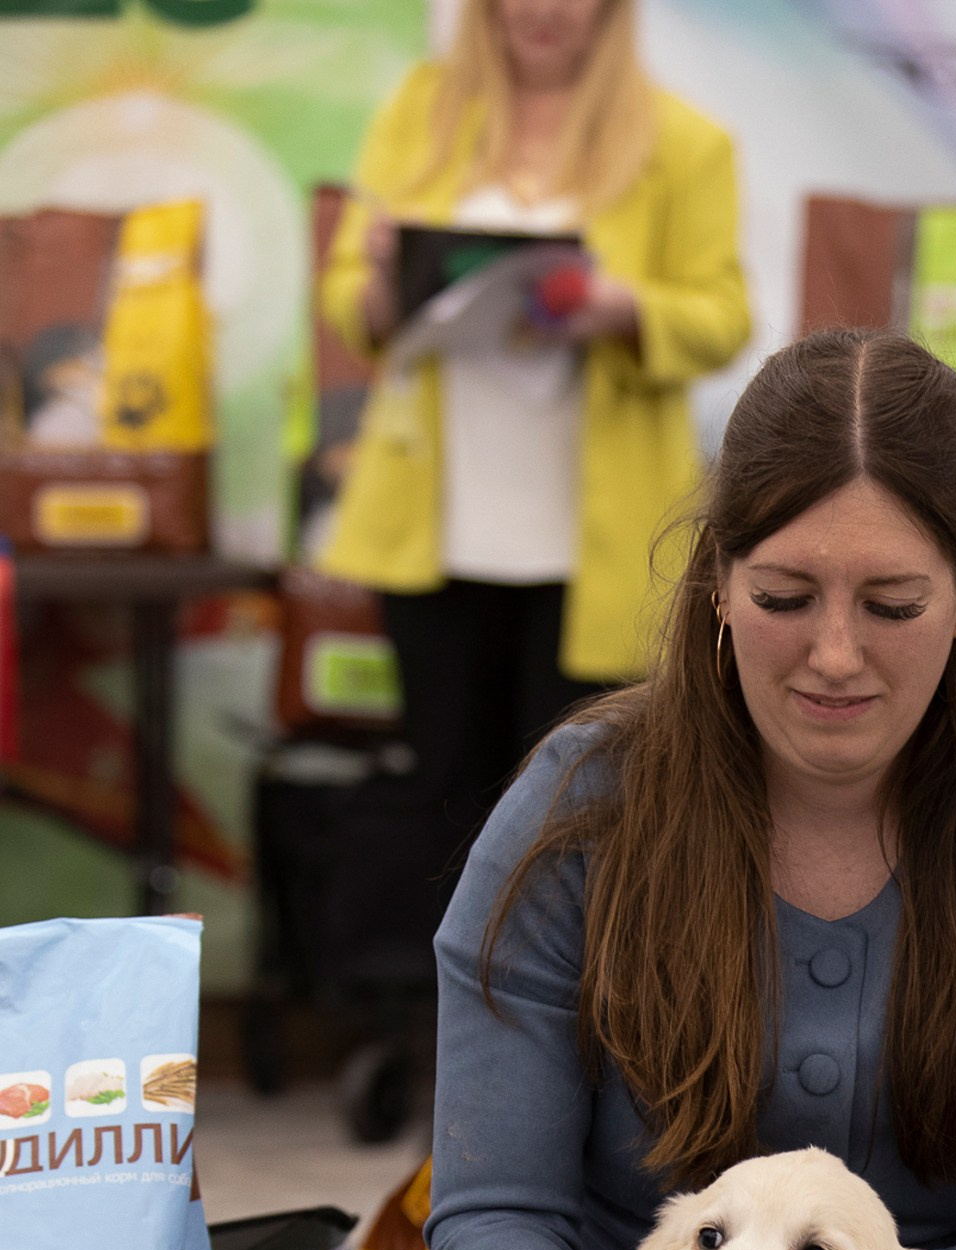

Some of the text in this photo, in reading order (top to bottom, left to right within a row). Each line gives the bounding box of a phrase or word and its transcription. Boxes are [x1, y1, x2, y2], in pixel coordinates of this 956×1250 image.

[0, 1172, 100, 1195] олнорационный
[104, 1172, 137, 1184] корм
[141, 1172, 165, 1184] для
